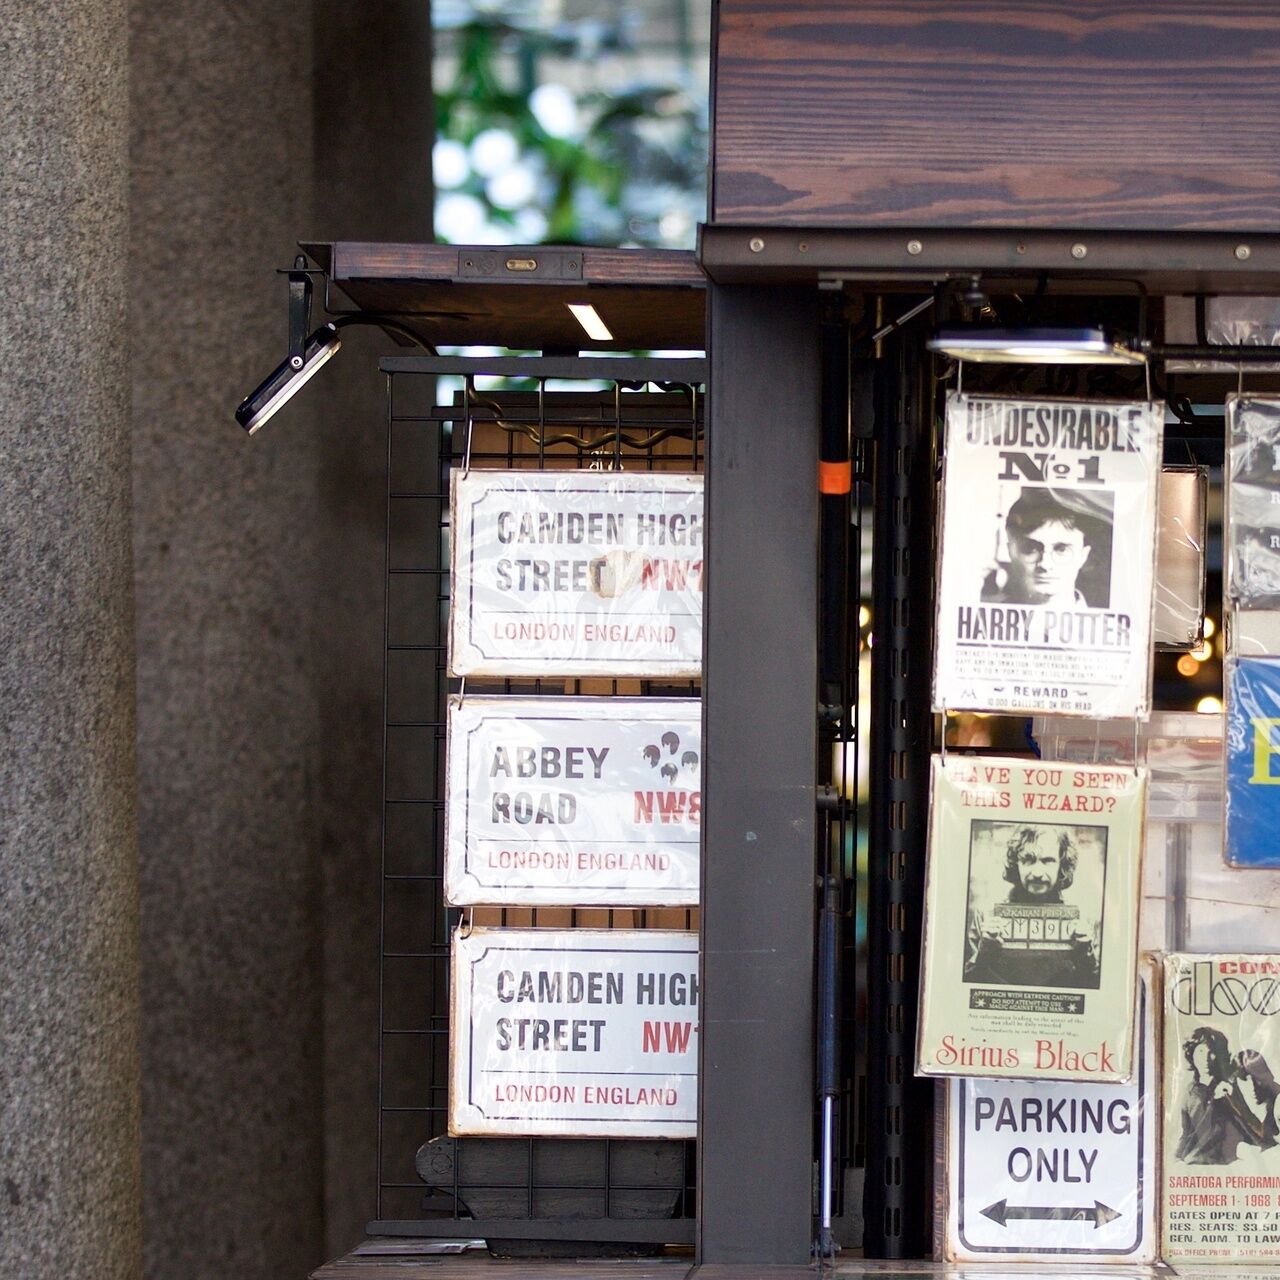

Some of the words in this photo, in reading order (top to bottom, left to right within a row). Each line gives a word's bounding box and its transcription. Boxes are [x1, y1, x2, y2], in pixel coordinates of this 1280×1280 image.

[967, 402, 1141, 453] UNDESIRABLE
[498, 512, 624, 545] CAMDEN
[637, 514, 703, 545] HIGH
[496, 558, 607, 592] STREET
[641, 558, 703, 592] NW1
[494, 623, 575, 641] LONDON
[585, 624, 676, 643] ENGLAND
[957, 606, 1035, 642] HARRY
[1043, 611, 1131, 647] POTTER
[1013, 686, 1068, 698] REWARD
[490, 746, 609, 779] ABBEY
[1022, 768, 1063, 787] YOU
[1073, 771, 1128, 790] SEEN
[492, 791, 577, 824] ROAD
[634, 791, 701, 824] NW8
[960, 790, 1011, 809] THIS
[1022, 793, 1117, 814] WIZARD?
[489, 851, 569, 870] LONDON
[578, 852, 671, 871] ENGLAND
[497, 970, 623, 1005] CAMDEN
[496, 1018, 605, 1052] STREET
[642, 1021, 698, 1053] NW
[936, 1035, 1020, 1068] Sirius
[1034, 1039, 1116, 1073] Black
[496, 1084, 574, 1103] LONDON
[584, 1087, 678, 1106] ENGLAND
[975, 1097, 1131, 1134] PARKING
[1008, 1147, 1098, 1183] ONLY
[1169, 1176, 1222, 1188] SARATOGA
